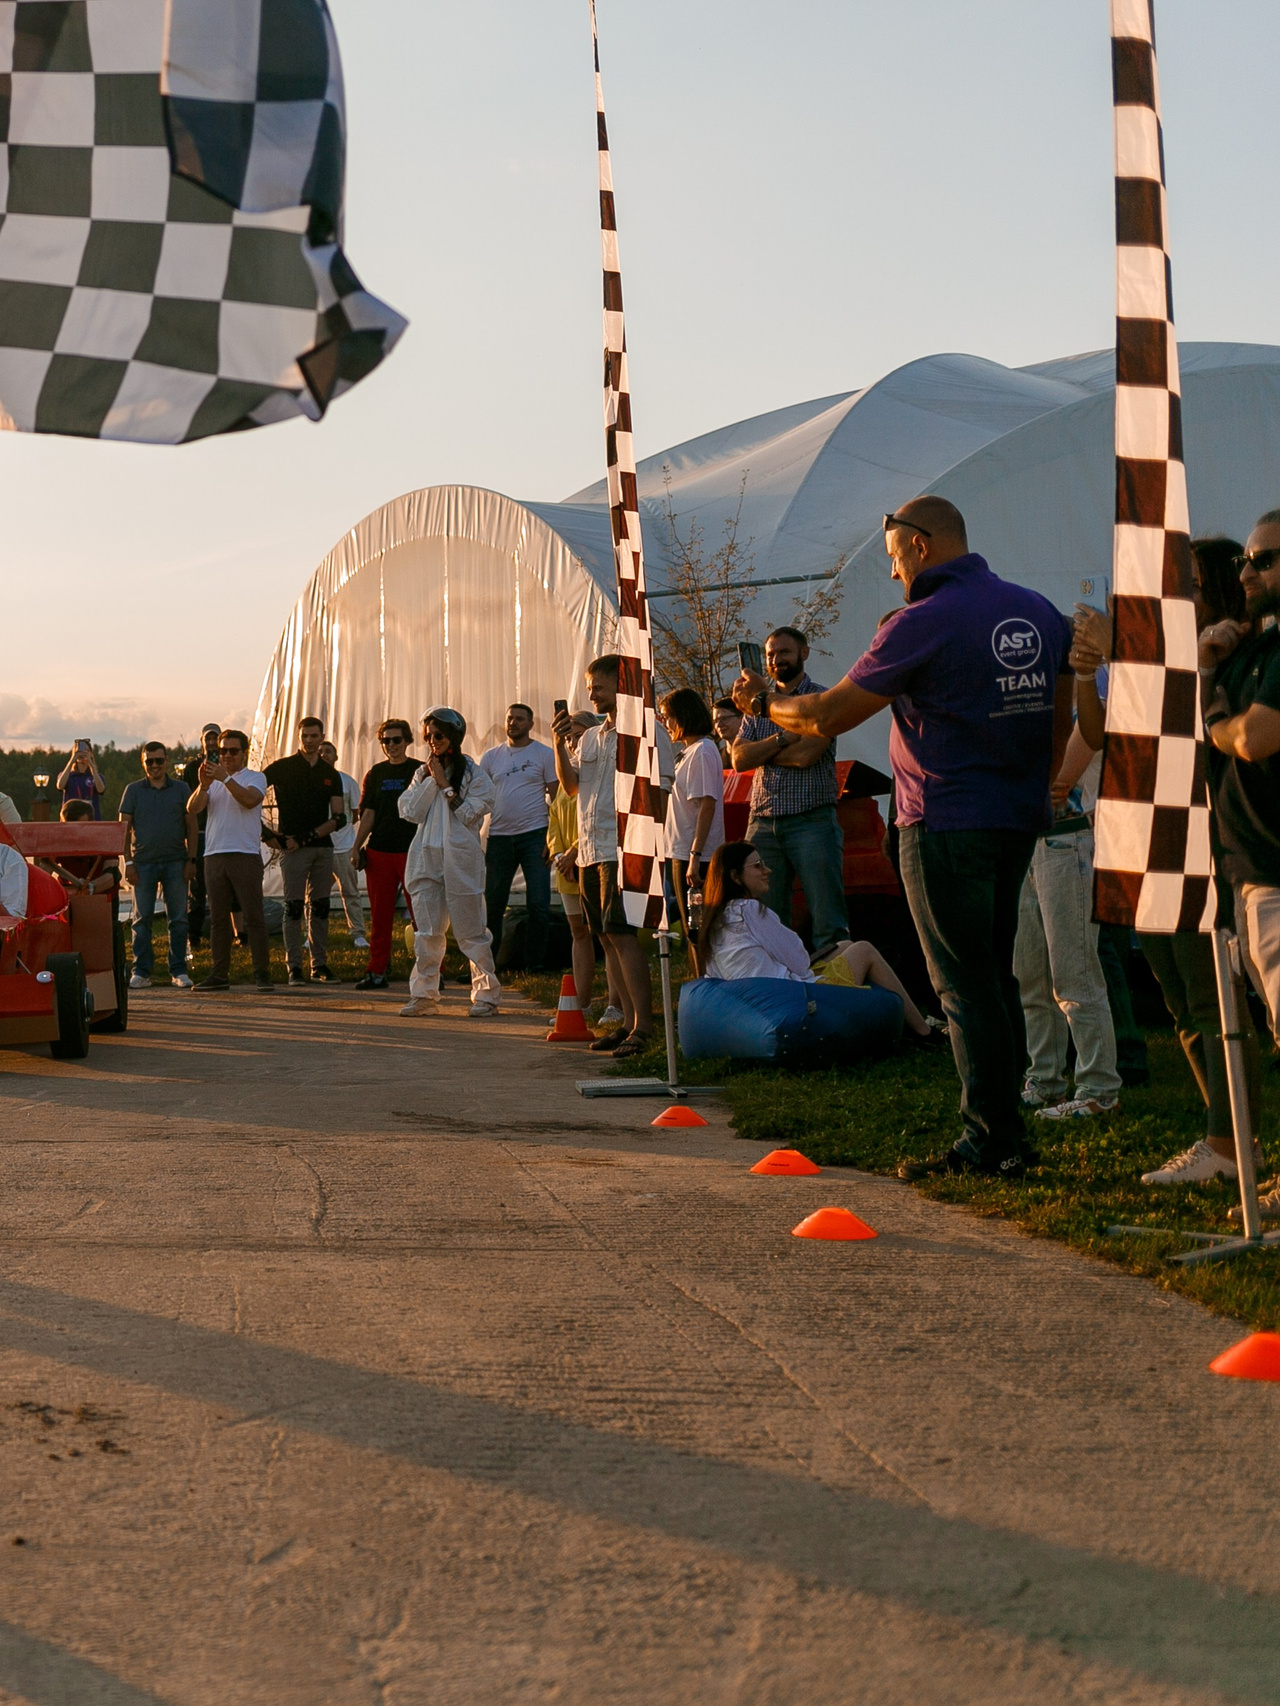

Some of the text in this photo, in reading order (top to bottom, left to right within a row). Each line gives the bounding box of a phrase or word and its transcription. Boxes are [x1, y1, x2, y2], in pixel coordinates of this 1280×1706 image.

[999, 631, 1034, 651] AST
[1018, 648, 1036, 657] group
[996, 672, 1046, 692] TEAM
